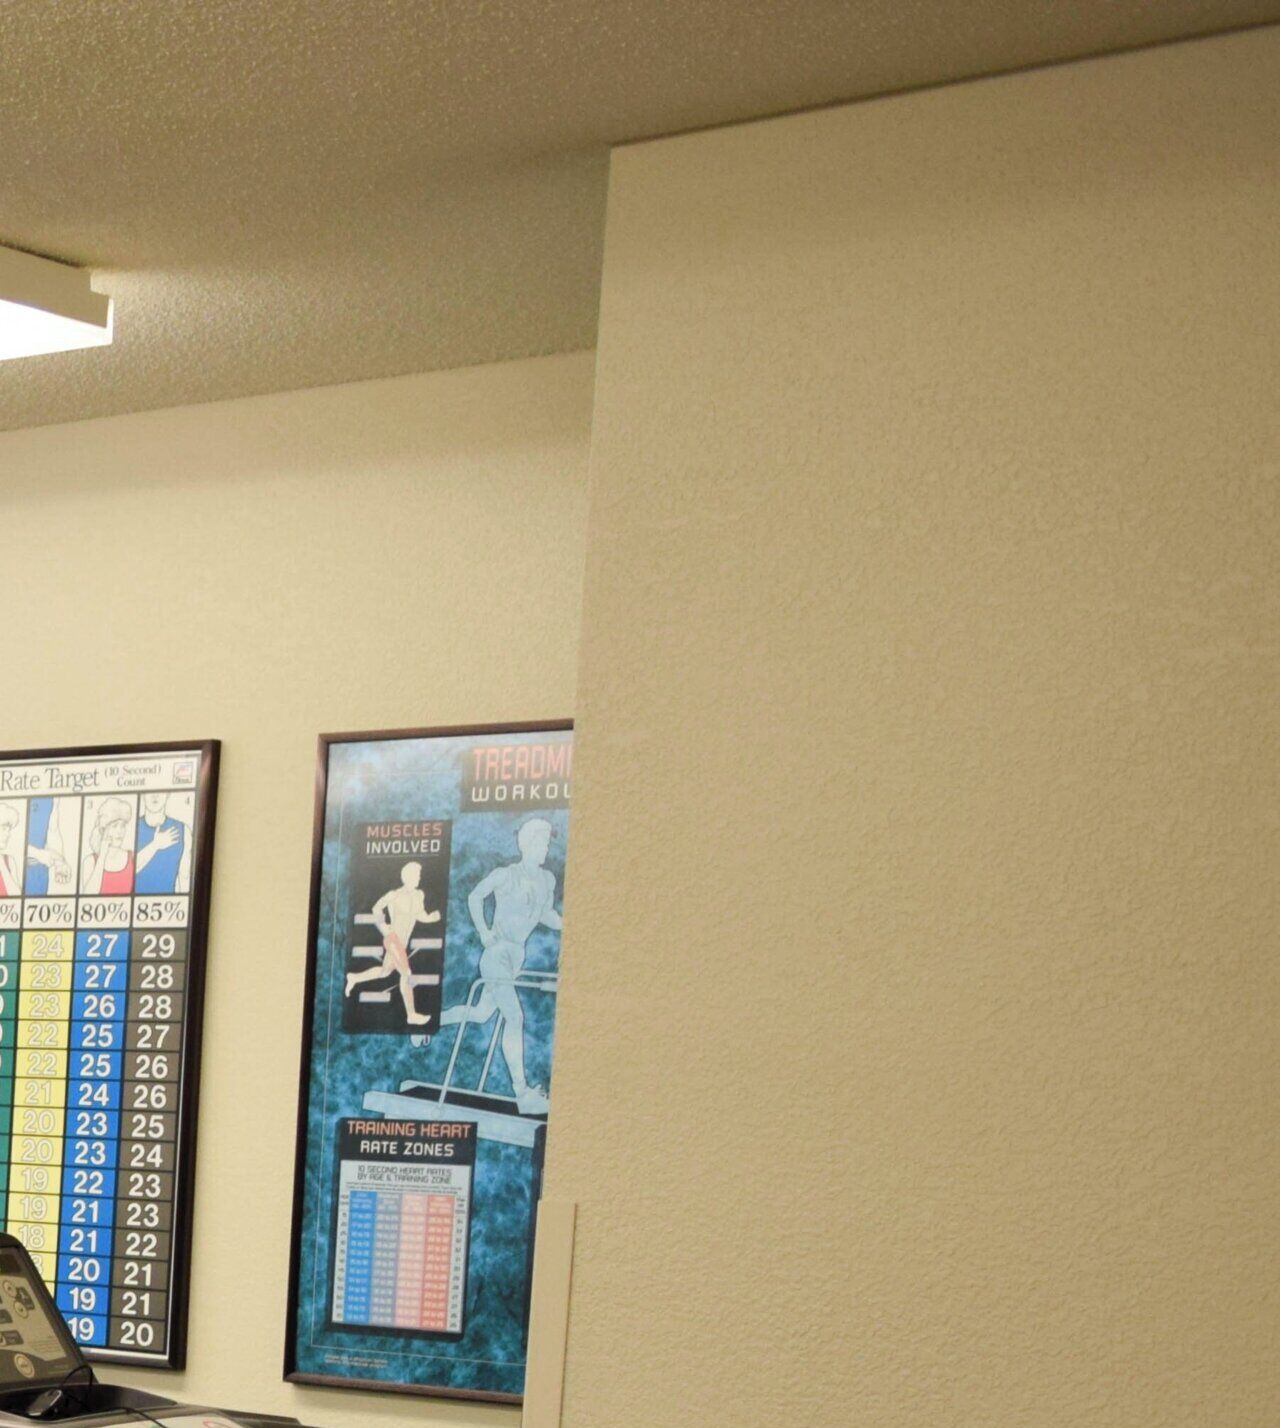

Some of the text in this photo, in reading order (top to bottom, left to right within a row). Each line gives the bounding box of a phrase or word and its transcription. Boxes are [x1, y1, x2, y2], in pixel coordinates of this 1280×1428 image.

[0, 770, 40, 791] Rate
[45, 767, 99, 791] Target
[117, 777, 145, 787] Count
[366, 822, 443, 839] MUSCLES
[366, 839, 441, 855] INVOLVED
[26, 903, 72, 923] 70%
[80, 902, 128, 922] 80%
[136, 901, 185, 922] 85%
[32, 934, 64, 958] 24
[87, 934, 118, 957] 27
[142, 934, 175, 958] 29
[32, 963, 62, 988] 23
[85, 965, 116, 988] 27
[141, 965, 173, 988] 28
[31, 992, 61, 1018] 23
[84, 994, 115, 1018] 26
[139, 995, 171, 1019] 28
[29, 1024, 57, 1045] 22
[82, 1023, 113, 1047] 25
[137, 1025, 169, 1048] 27
[27, 1052, 57, 1074] 22
[80, 1053, 110, 1077] 25
[136, 1055, 167, 1079] 26
[26, 1080, 53, 1102] 21
[79, 1083, 109, 1106] 24
[134, 1085, 166, 1108] 26
[23, 1110, 55, 1132] 20
[76, 1112, 107, 1136] 23
[132, 1114, 164, 1138] 25
[347, 1121, 471, 1138] TRAINING HEART
[23, 1140, 52, 1161] 20
[75, 1141, 106, 1165] 23
[131, 1144, 162, 1167] 24
[360, 1140, 454, 1157] RATE ZONES
[22, 1167, 49, 1190] 19
[74, 1170, 103, 1194] 22
[129, 1173, 160, 1197] 23
[367, 1165, 398, 1174] SECOND
[400, 1167, 424, 1175] HEART
[427, 1168, 452, 1176] RATES
[369, 1173, 383, 1181] AGE
[394, 1174, 429, 1183] TRAINING
[431, 1176, 451, 1184] ZONE
[21, 1196, 46, 1218] 19
[72, 1199, 98, 1223] 21
[127, 1203, 159, 1227] 23
[19, 1226, 45, 1249] 18
[70, 1229, 96, 1252] 21
[126, 1233, 157, 1257] 22
[68, 1258, 100, 1281] 20
[124, 1262, 151, 1286] 21
[70, 1288, 149, 1315] 19 21
[68, 1317, 153, 1346] 19 20
